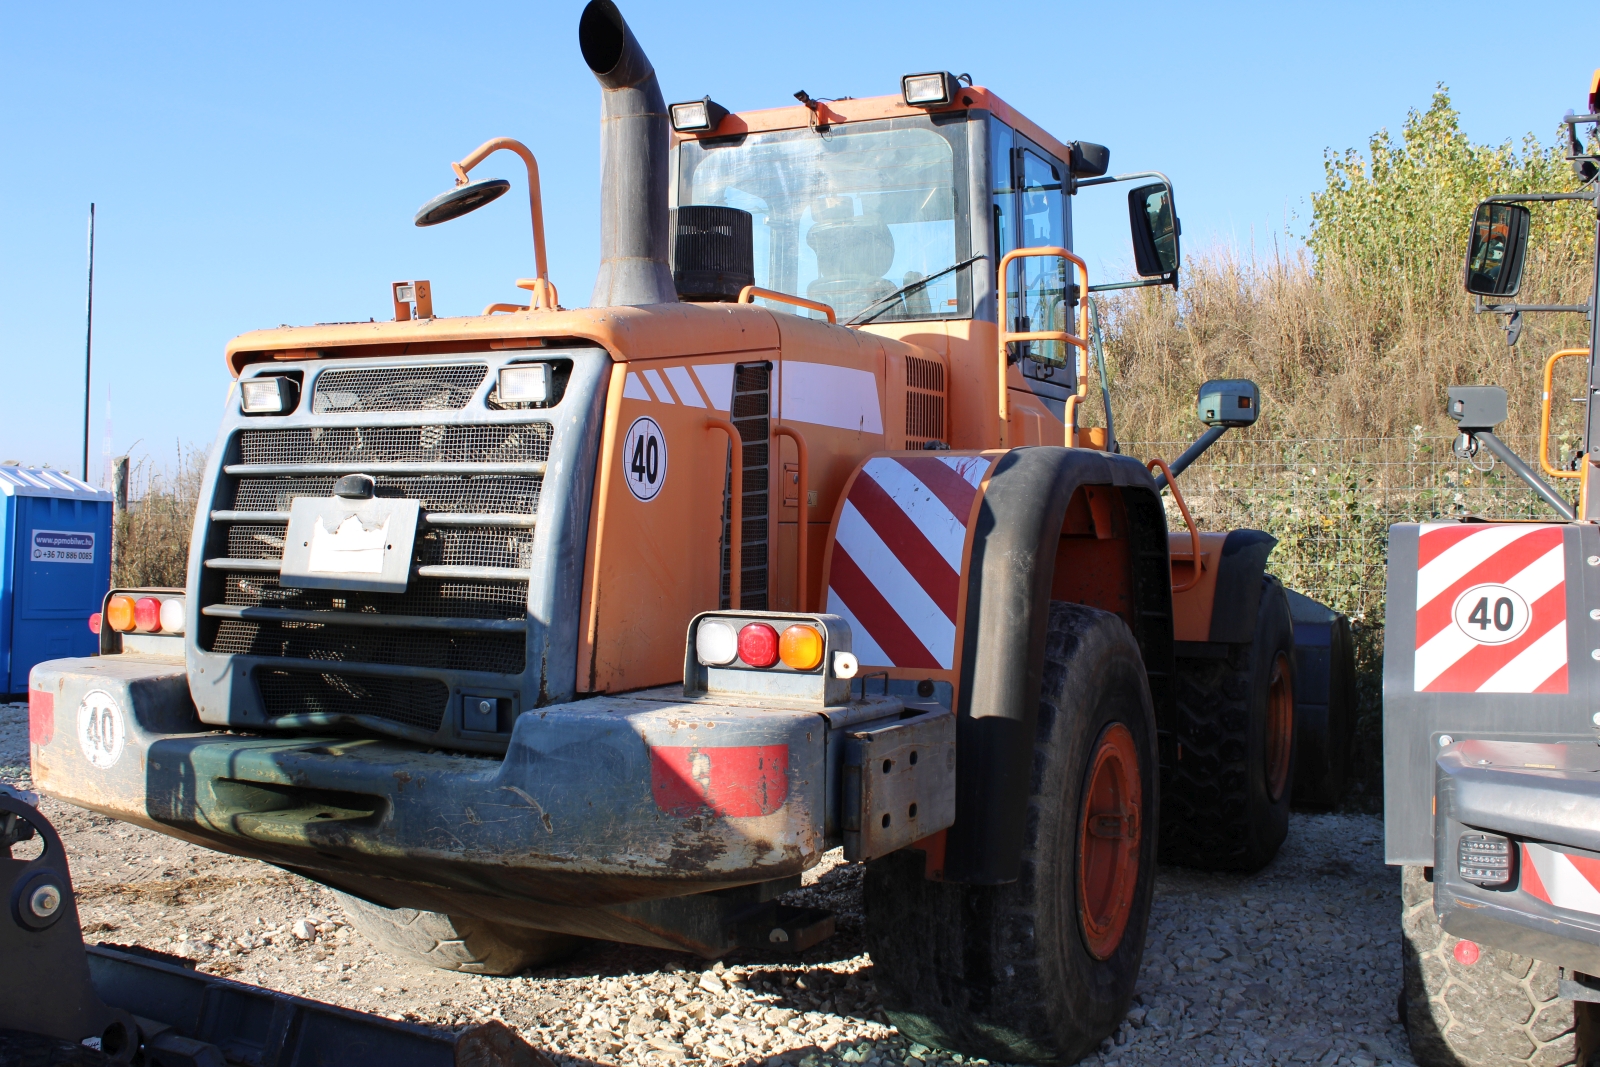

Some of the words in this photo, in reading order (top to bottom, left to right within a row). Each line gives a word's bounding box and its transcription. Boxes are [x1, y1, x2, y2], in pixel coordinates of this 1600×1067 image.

[632, 434, 658, 484] 40
[43, 550, 55, 558] +36
[57, 551, 65, 559] 70
[1468, 597, 1514, 631] 40
[87, 707, 114, 753] 40
